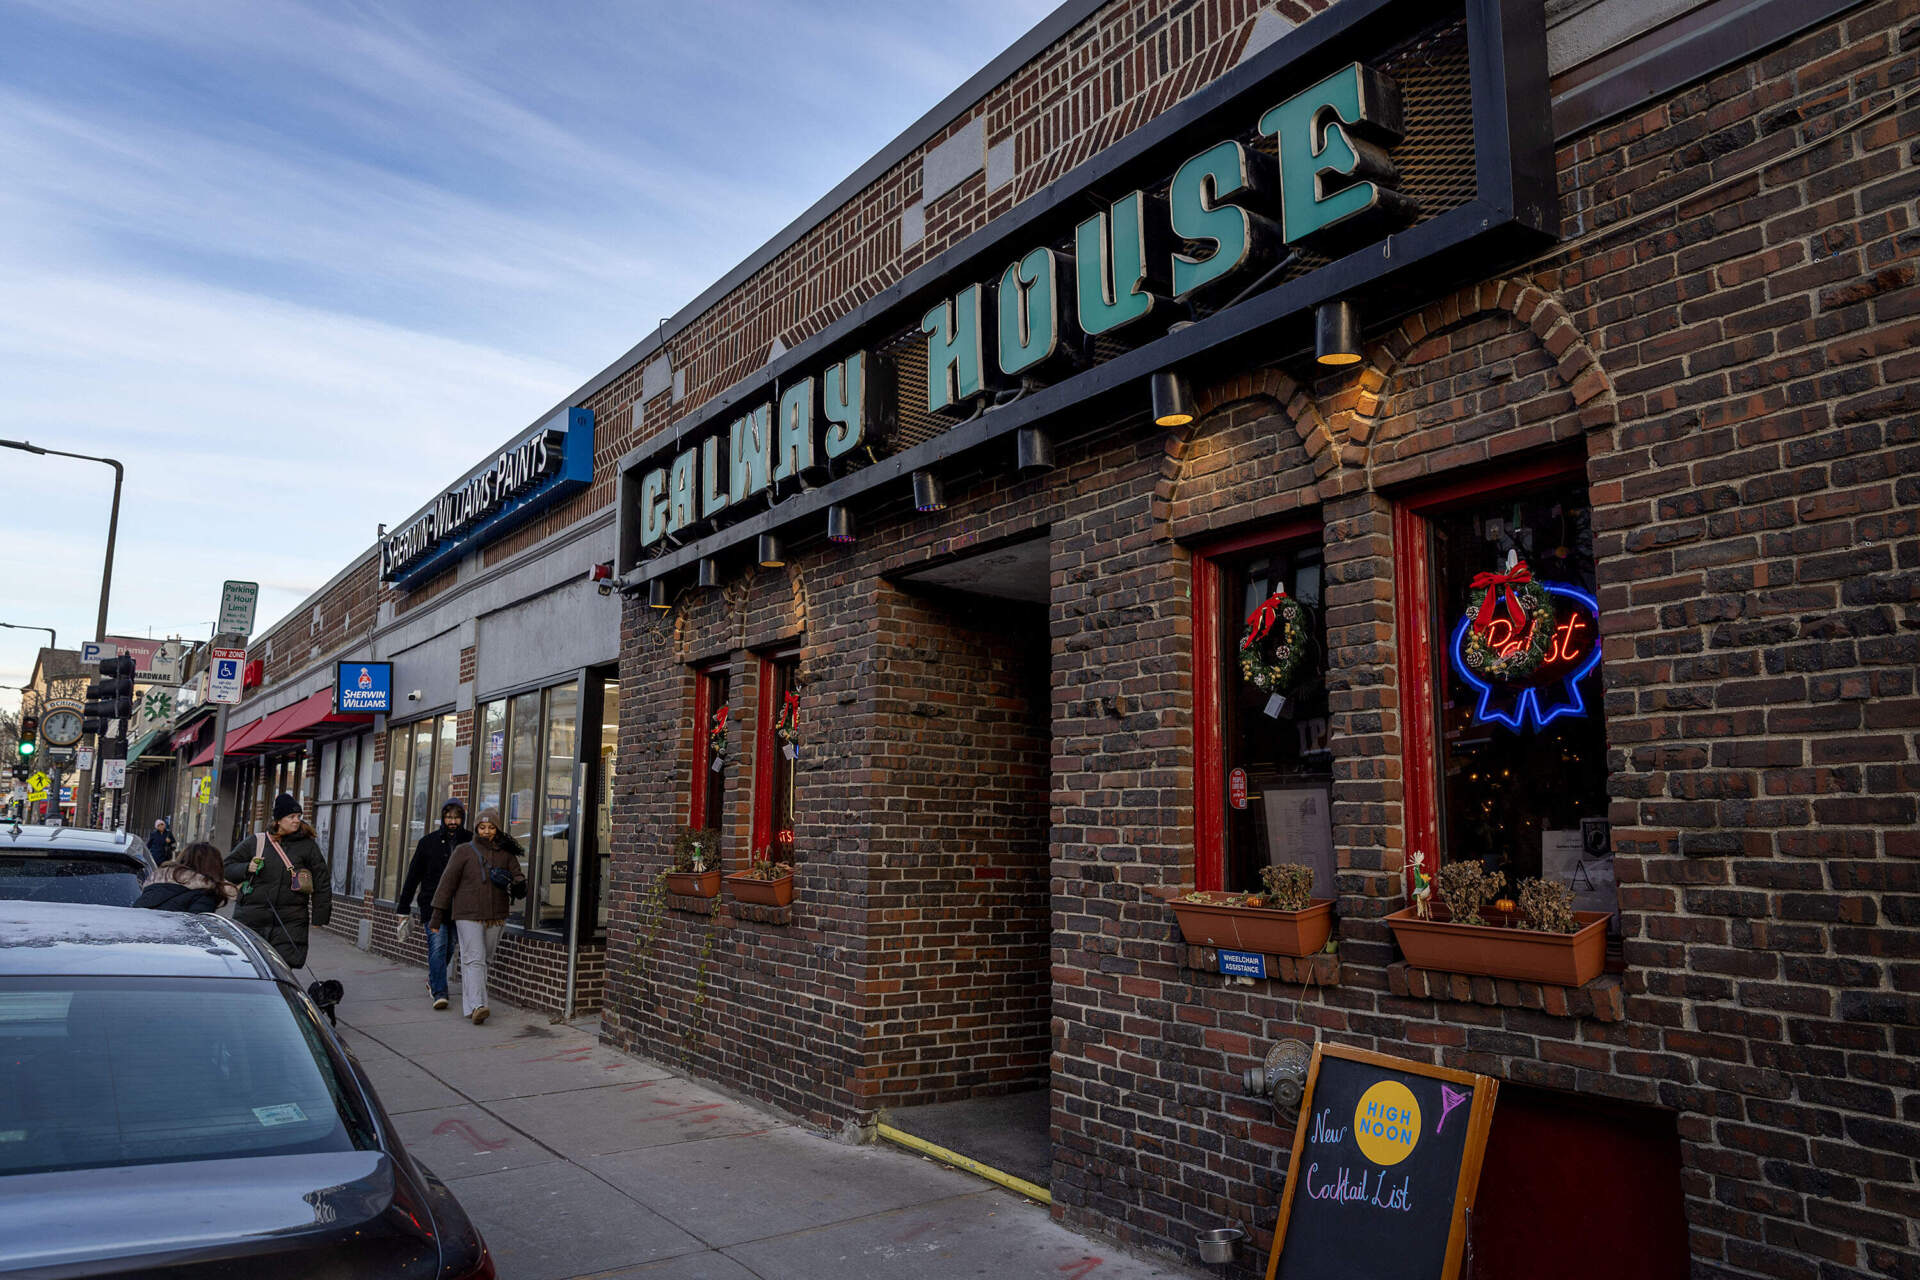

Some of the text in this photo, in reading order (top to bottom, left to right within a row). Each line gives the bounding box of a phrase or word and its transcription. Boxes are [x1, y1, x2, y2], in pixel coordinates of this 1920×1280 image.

[641, 61, 1379, 547] GALWAY HOUSE
[495, 428, 549, 501] PAINTS
[225, 584, 255, 595] Parking
[234, 595, 253, 603] Hour
[228, 603, 248, 612] Limit
[228, 651, 245, 659] ZONE
[134, 671, 170, 681] HARDWARE
[343, 689, 386, 699] SHERWIN
[343, 698, 386, 708] WILLIAMS
[1223, 954, 1260, 965] WHEELCHAIR
[1225, 963, 1260, 974] ASSISTANCE
[1367, 1101, 1411, 1125] HIGH
[1311, 1108, 1347, 1143] New
[1360, 1117, 1412, 1145] NOON
[1307, 1162, 1412, 1211] Cocktail List
